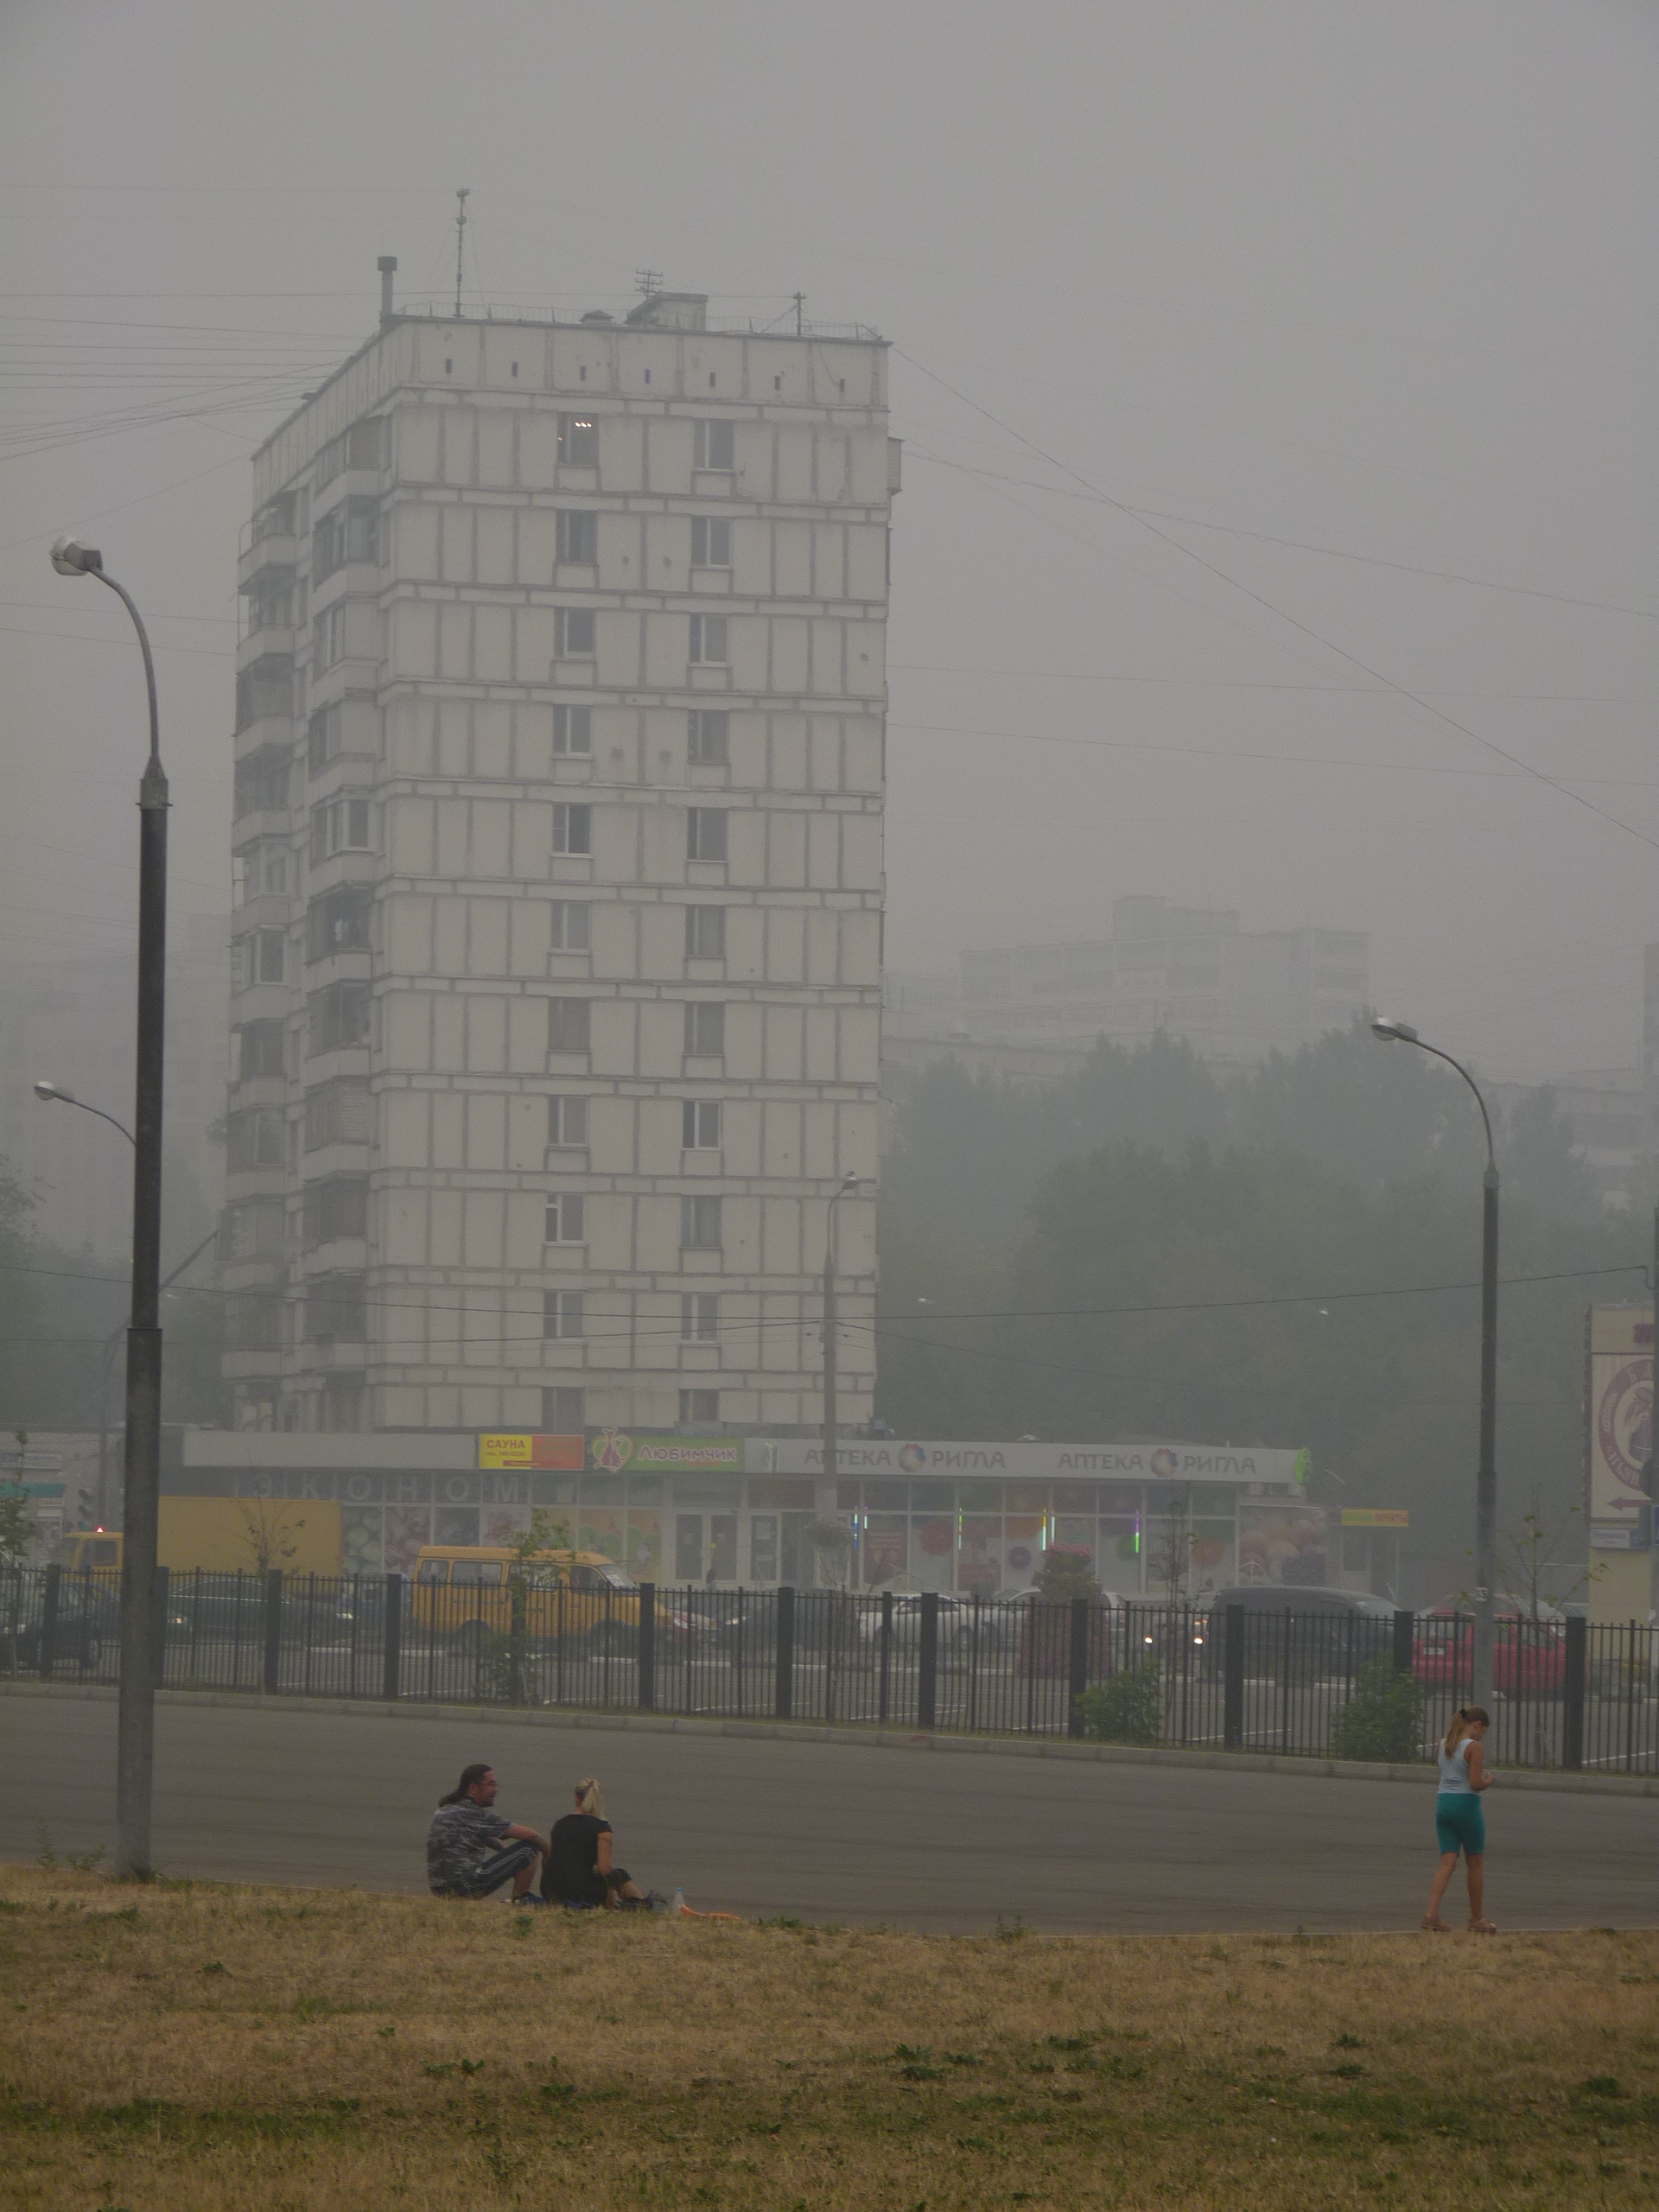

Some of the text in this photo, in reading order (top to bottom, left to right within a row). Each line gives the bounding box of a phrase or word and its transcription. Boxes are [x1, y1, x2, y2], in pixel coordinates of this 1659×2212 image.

[486, 1440, 526, 1449] САУНА
[804, 1449, 1006, 1469] АТЕКА РИГЛА
[1058, 1452, 1257, 1474] АПТЕКА РИГЛА
[252, 1473, 519, 1503] ЭКОНОМ
